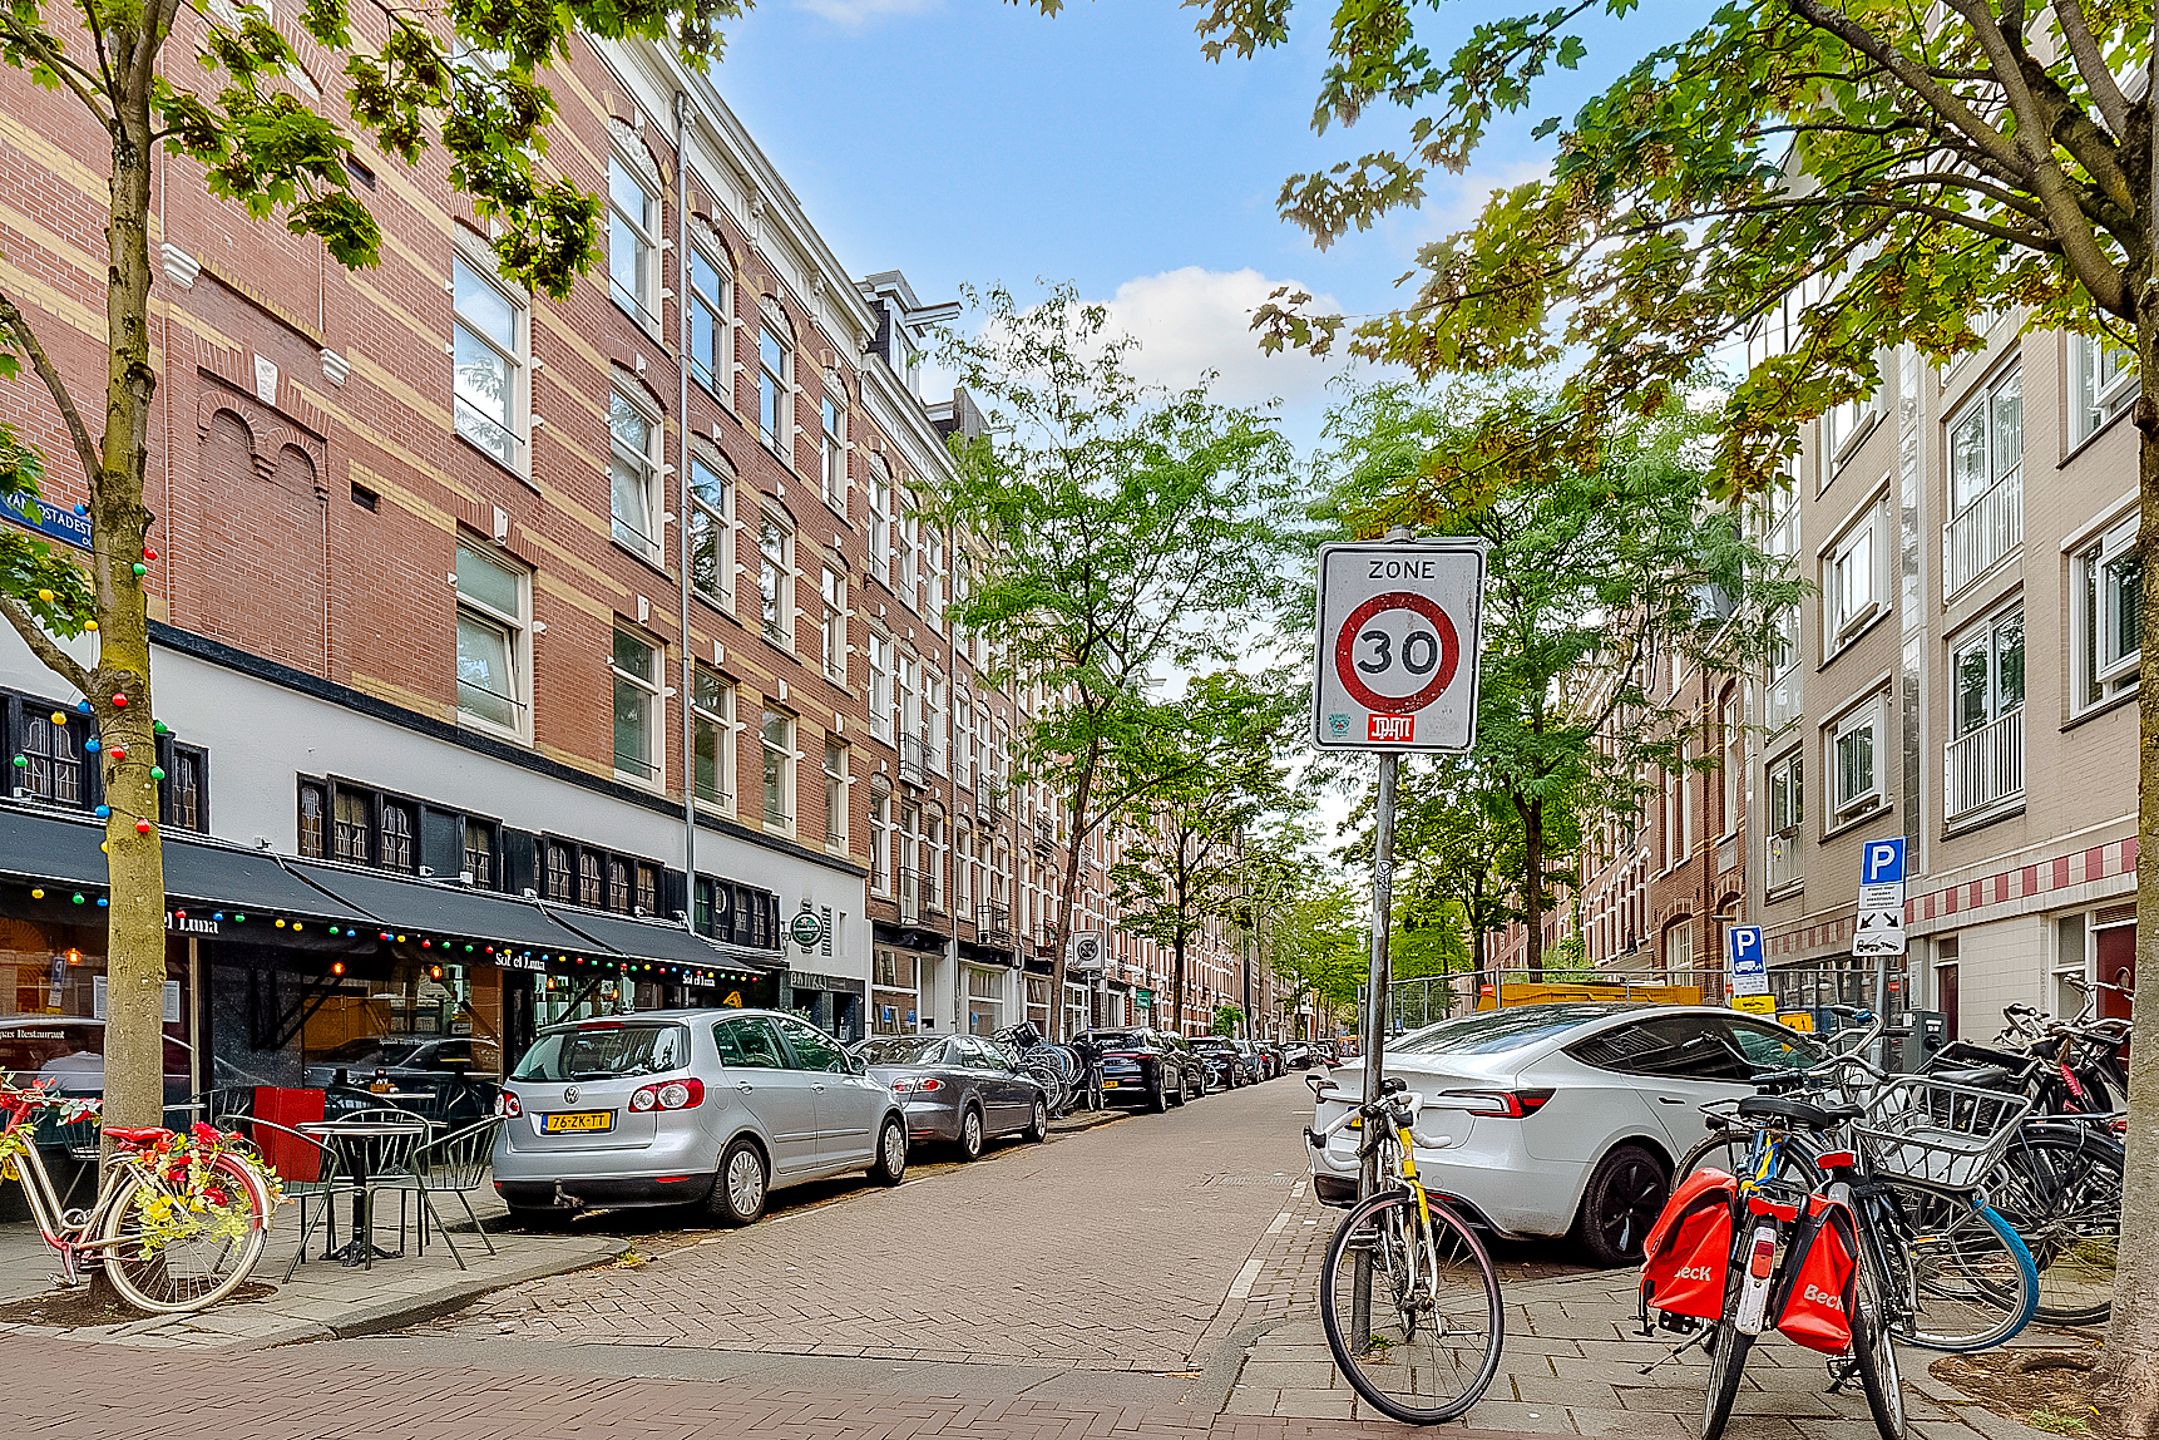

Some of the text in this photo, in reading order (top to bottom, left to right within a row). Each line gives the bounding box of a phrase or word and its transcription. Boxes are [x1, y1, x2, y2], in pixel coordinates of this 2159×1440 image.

[1368, 560, 1436, 579] ZONE
[1357, 630, 1438, 675] 30
[1870, 845, 1896, 880] P
[1736, 930, 1756, 957] P
[495, 952, 511, 967] Sol
[553, 1114, 605, 1129] 76-ZK-TT
